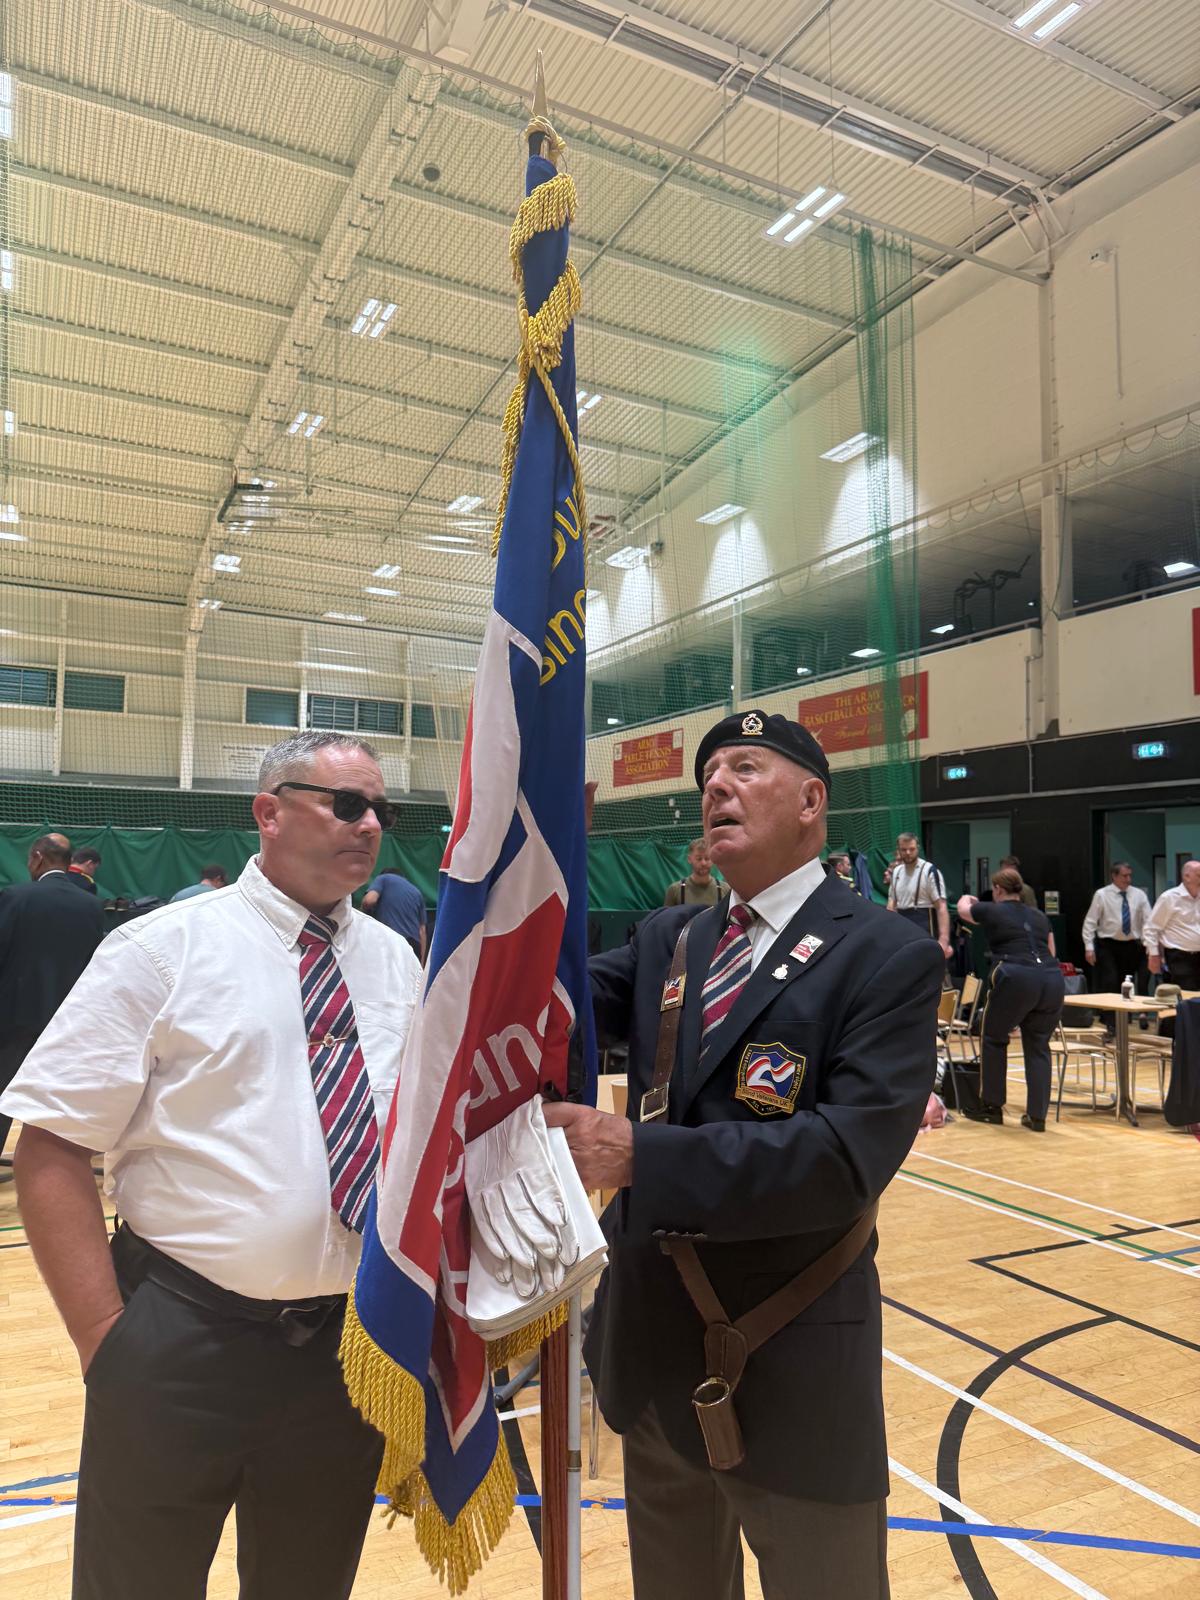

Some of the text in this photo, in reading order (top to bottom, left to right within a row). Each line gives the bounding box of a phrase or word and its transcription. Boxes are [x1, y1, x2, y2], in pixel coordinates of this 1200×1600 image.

[835, 687, 882, 709] THE ARMY
[804, 707, 854, 728] BASKETBALL
[636, 737, 655, 751] ARMY
[624, 747, 672, 764] TABLE TENNIS
[625, 759, 669, 775] ASSOCIATION
[756, 1091, 779, 1105] Veterans
[779, 1098, 789, 1107] UK
